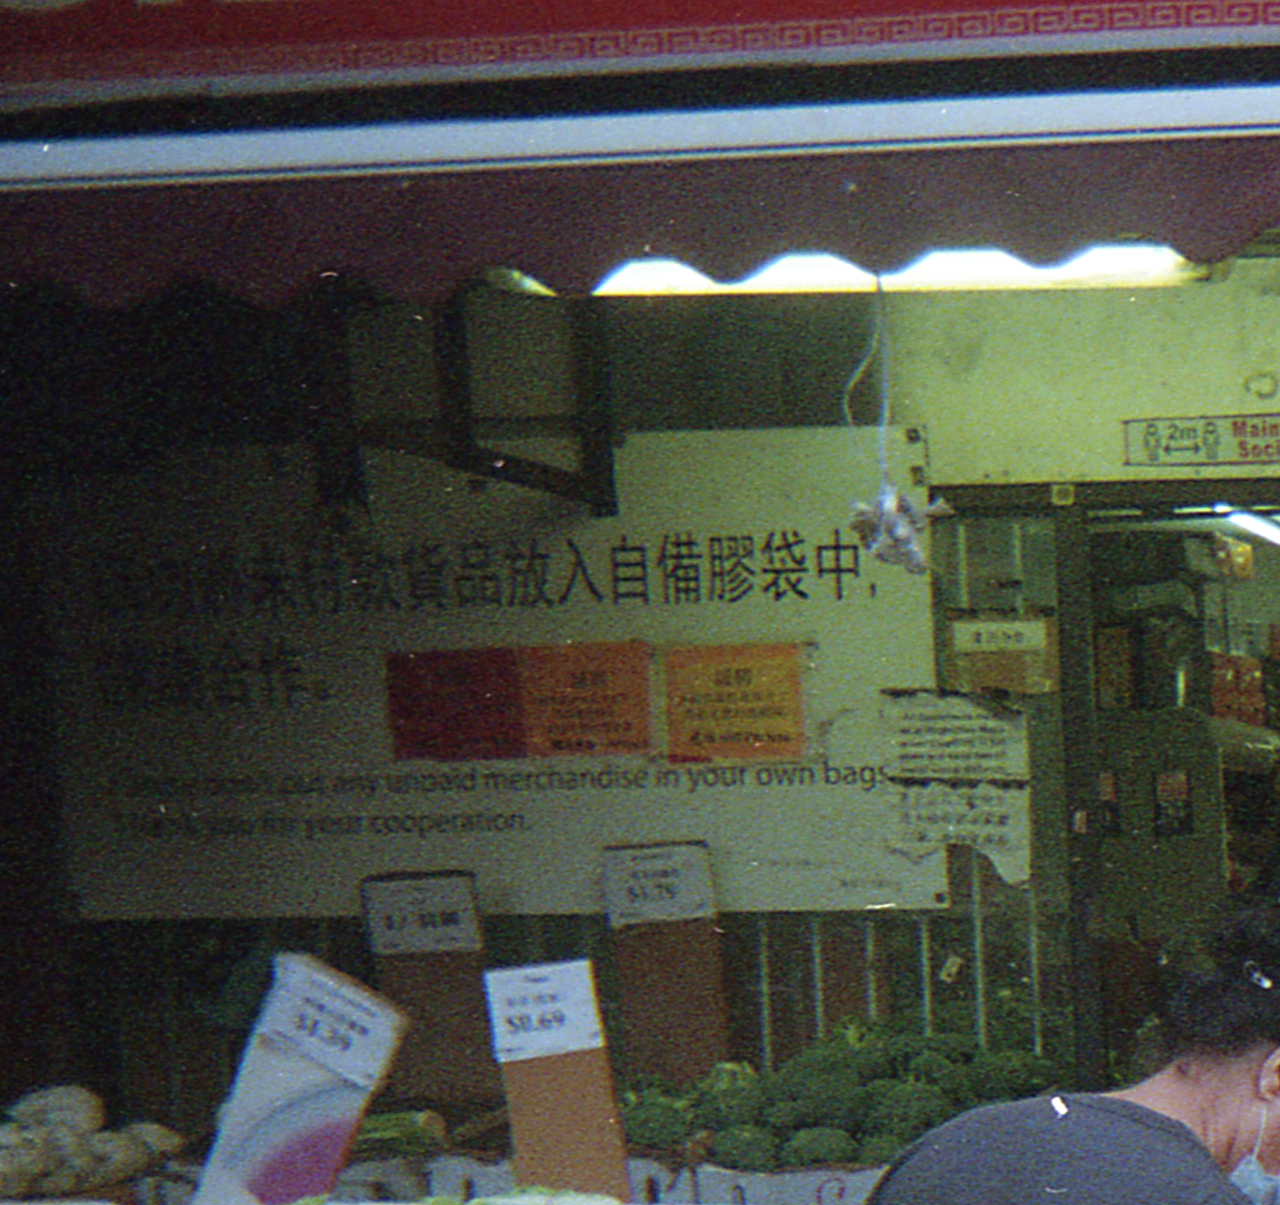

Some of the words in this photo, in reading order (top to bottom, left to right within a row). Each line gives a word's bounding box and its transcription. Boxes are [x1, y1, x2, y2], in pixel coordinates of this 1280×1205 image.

[1168, 424, 1198, 441] 2m
[96, 528, 880, 622] 未付款貨品放入自備膠袋中，
[388, 764, 480, 796] unpaid
[483, 762, 648, 792] merchandise
[653, 762, 682, 788] in
[686, 762, 750, 794] your
[756, 760, 818, 787] own
[370, 808, 524, 839] cooperation.
[505, 1009, 567, 1035] $0.69
